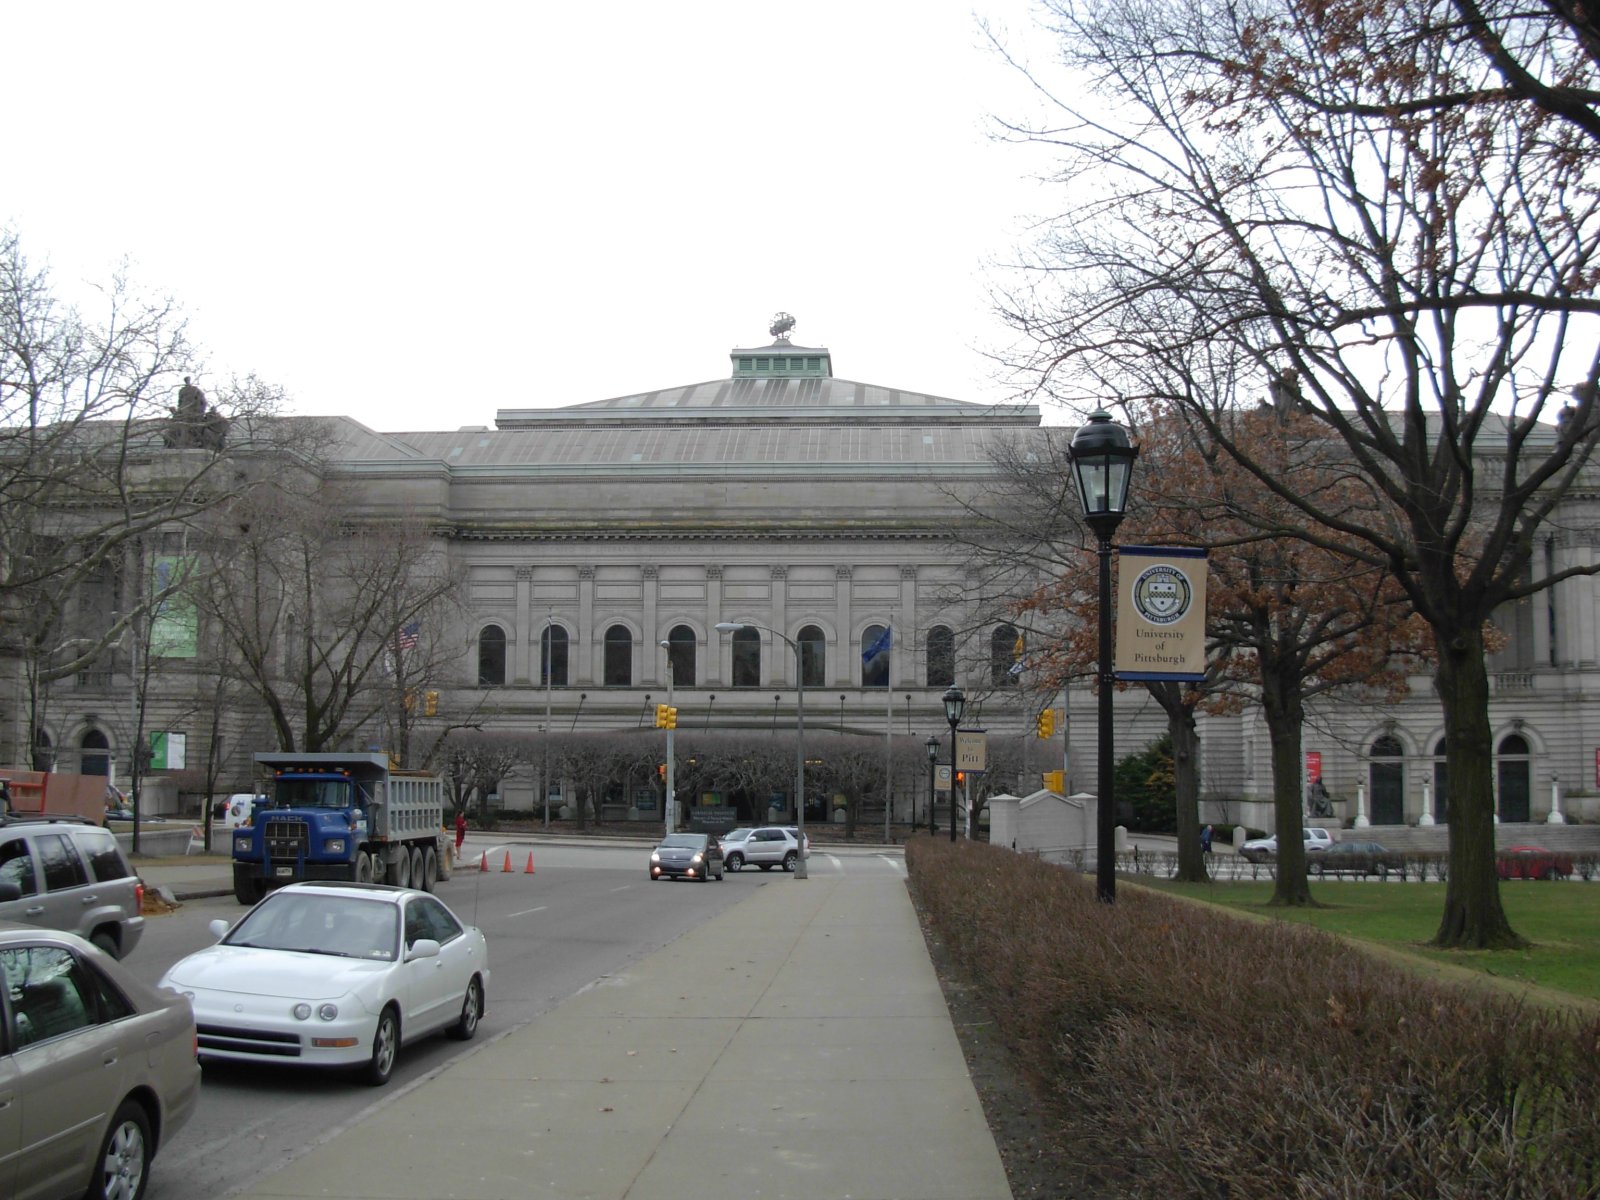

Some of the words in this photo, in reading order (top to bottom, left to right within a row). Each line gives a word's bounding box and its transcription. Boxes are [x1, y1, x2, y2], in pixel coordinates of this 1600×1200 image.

[1142, 568, 1176, 579] UNIVERSITY
[1144, 612, 1179, 622] PITTSBURGH
[1136, 629, 1185, 640] University
[1155, 641, 1165, 650] of
[1134, 653, 1185, 665] Pittsburgh
[962, 754, 978, 762] Pitt
